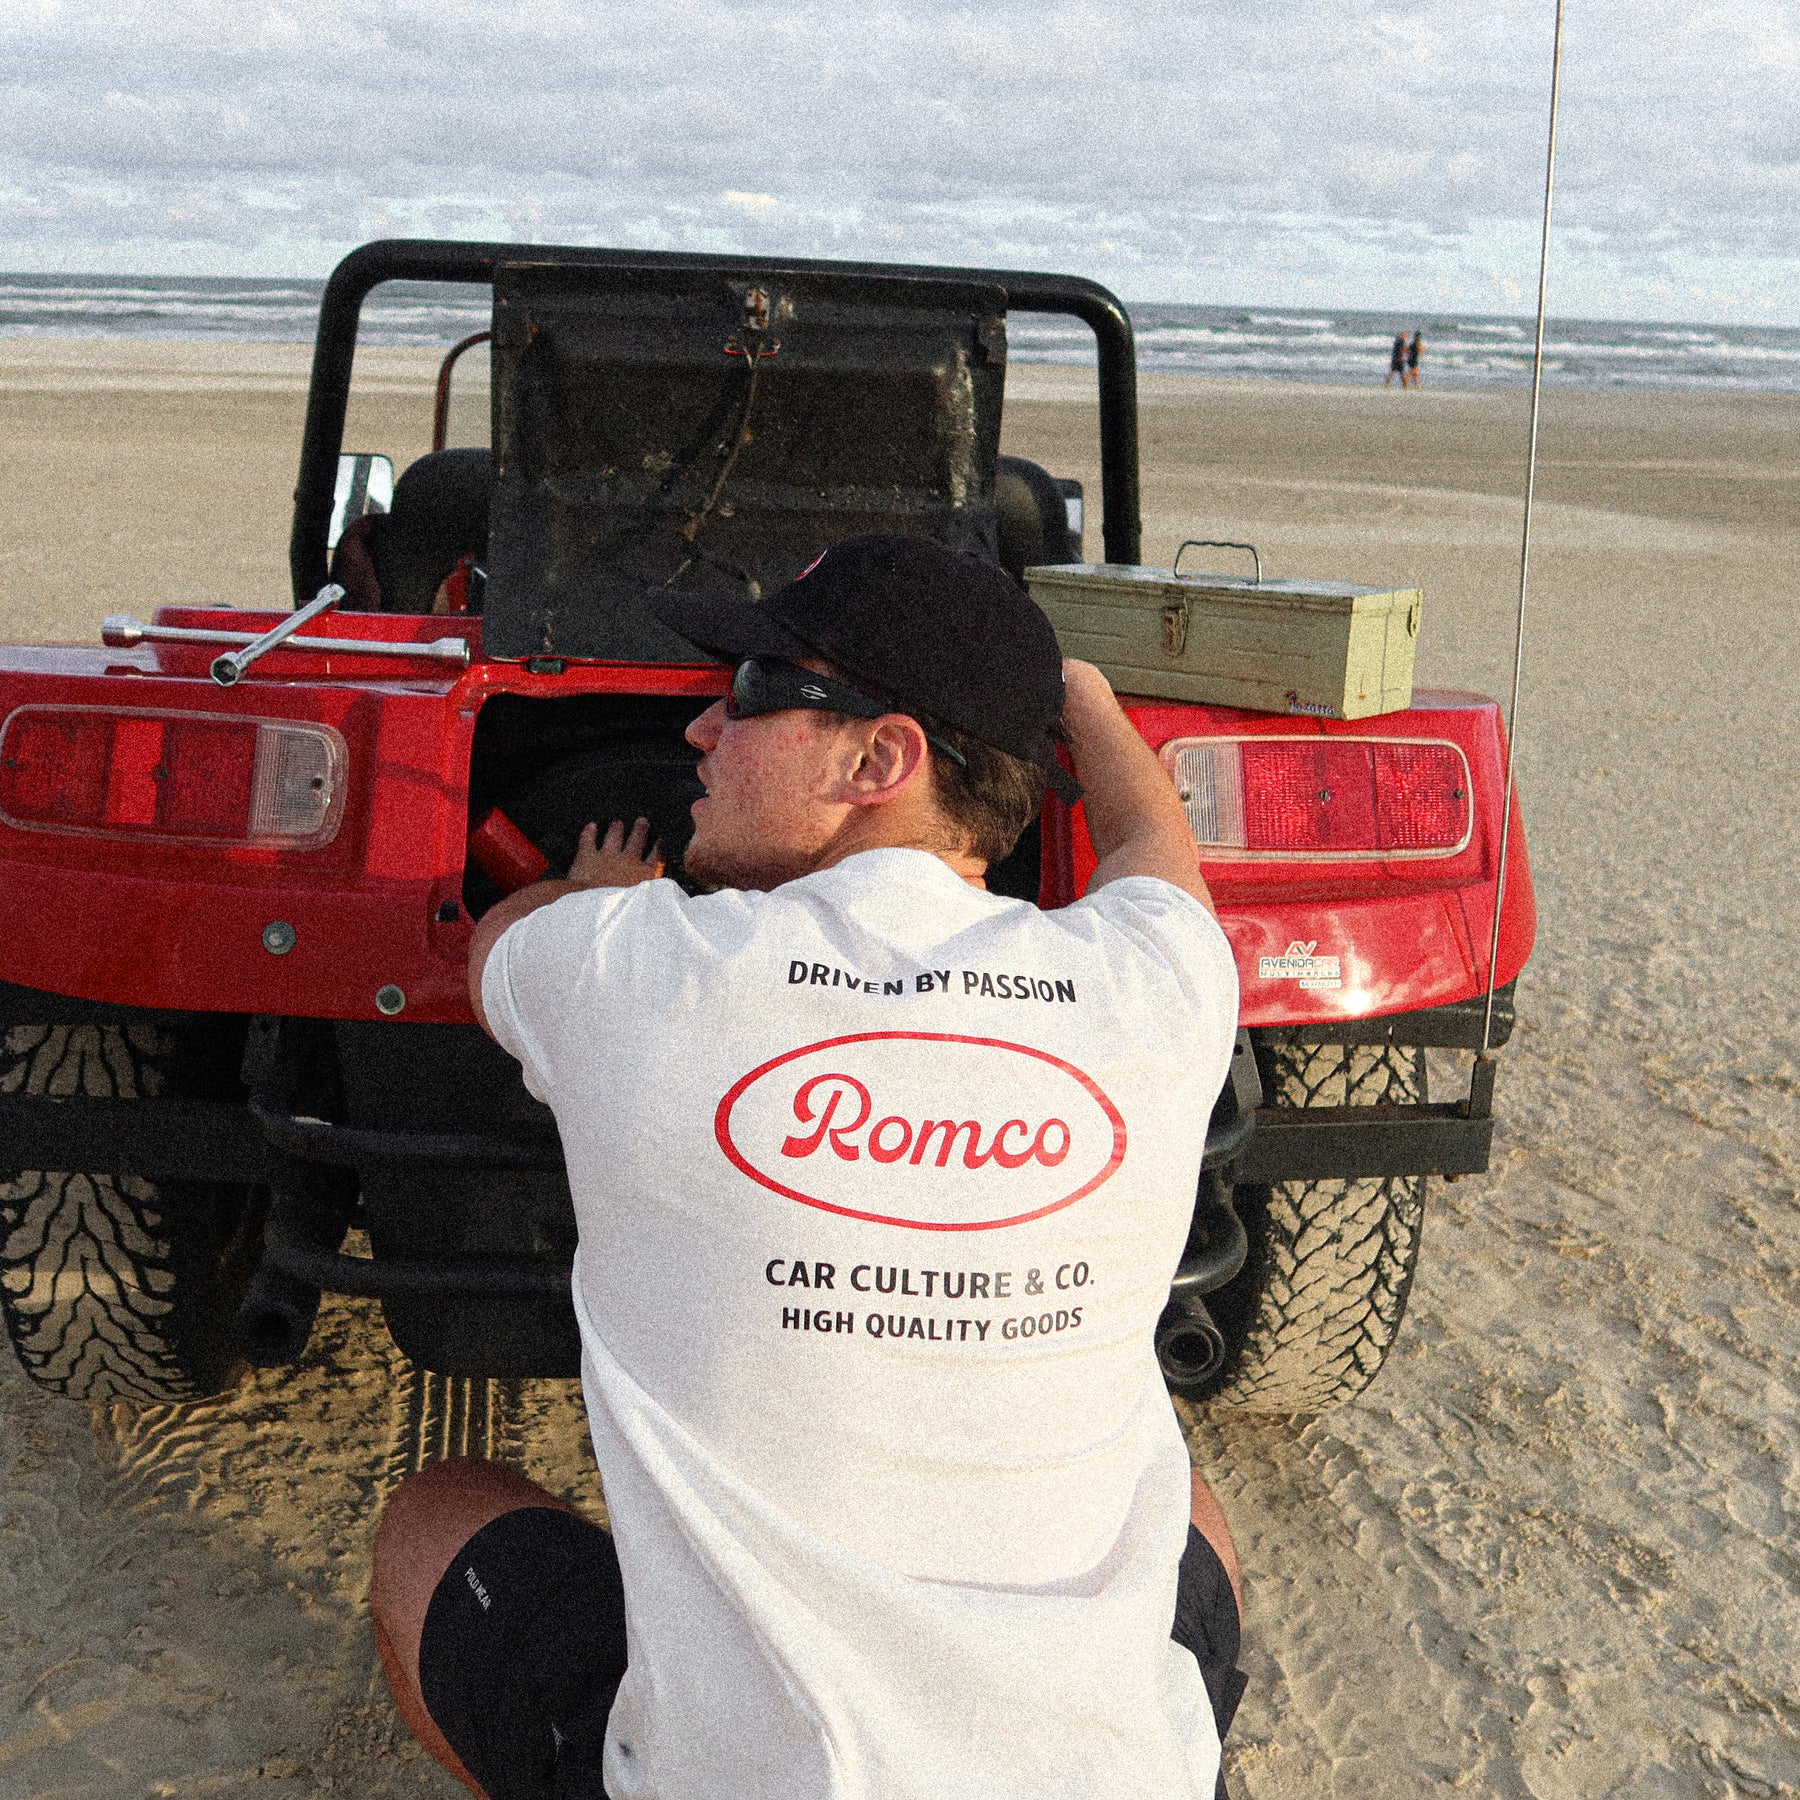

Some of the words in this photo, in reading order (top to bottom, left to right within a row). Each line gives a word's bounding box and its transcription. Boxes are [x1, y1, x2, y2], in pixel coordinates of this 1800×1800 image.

[788, 960, 904, 996] DRIVEN
[915, 969, 952, 993] BY
[962, 970, 1077, 1003] PASSION
[781, 1073, 1071, 1169] Romco
[765, 1258, 836, 1290] CAR
[849, 1264, 1013, 1299] CULTURE
[1024, 1268, 1045, 1295] &
[1055, 1261, 1096, 1290] CO.
[782, 1307, 854, 1334] HIGH
[865, 1313, 991, 1341] QUALITY
[1001, 1306, 1083, 1340] GOODS
